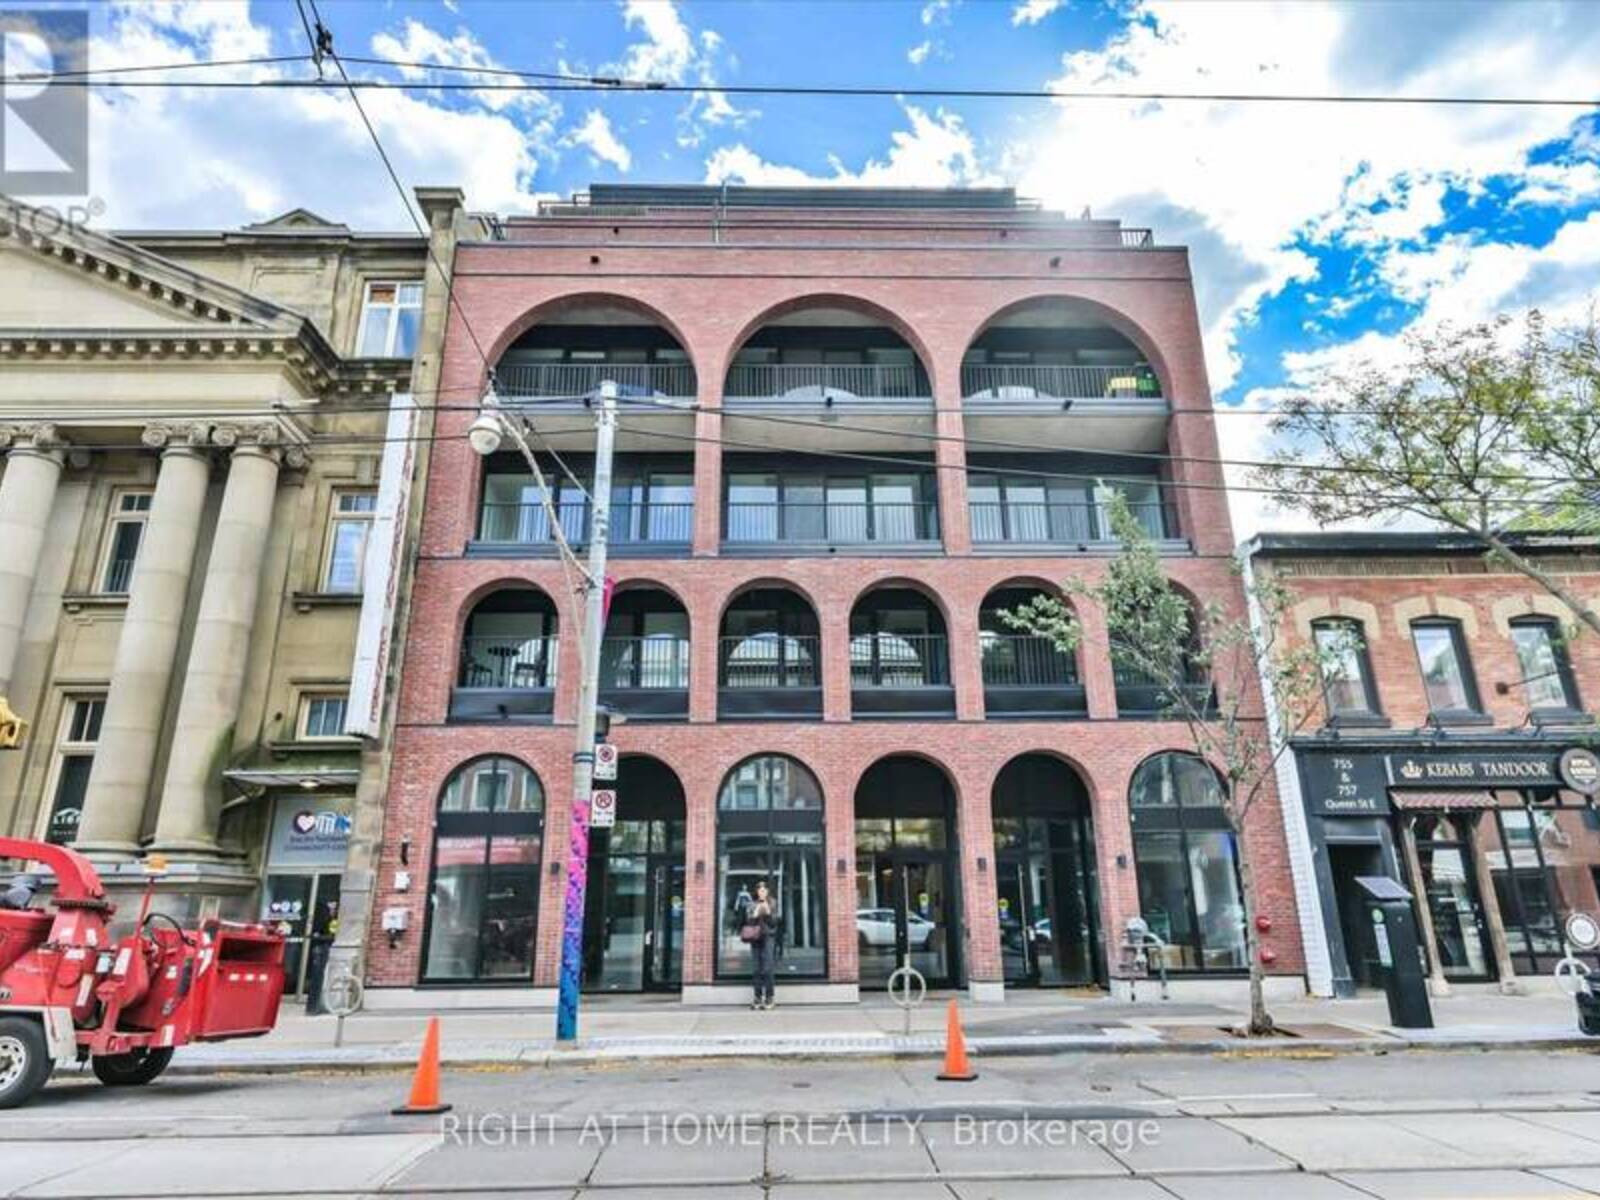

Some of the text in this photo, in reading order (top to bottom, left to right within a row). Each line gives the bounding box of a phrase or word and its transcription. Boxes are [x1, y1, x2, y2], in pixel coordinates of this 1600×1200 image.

[1426, 761, 1550, 777] KEBABS TANDOOR
[1337, 783, 1357, 796] 757
[1325, 798, 1357, 810] Queen
